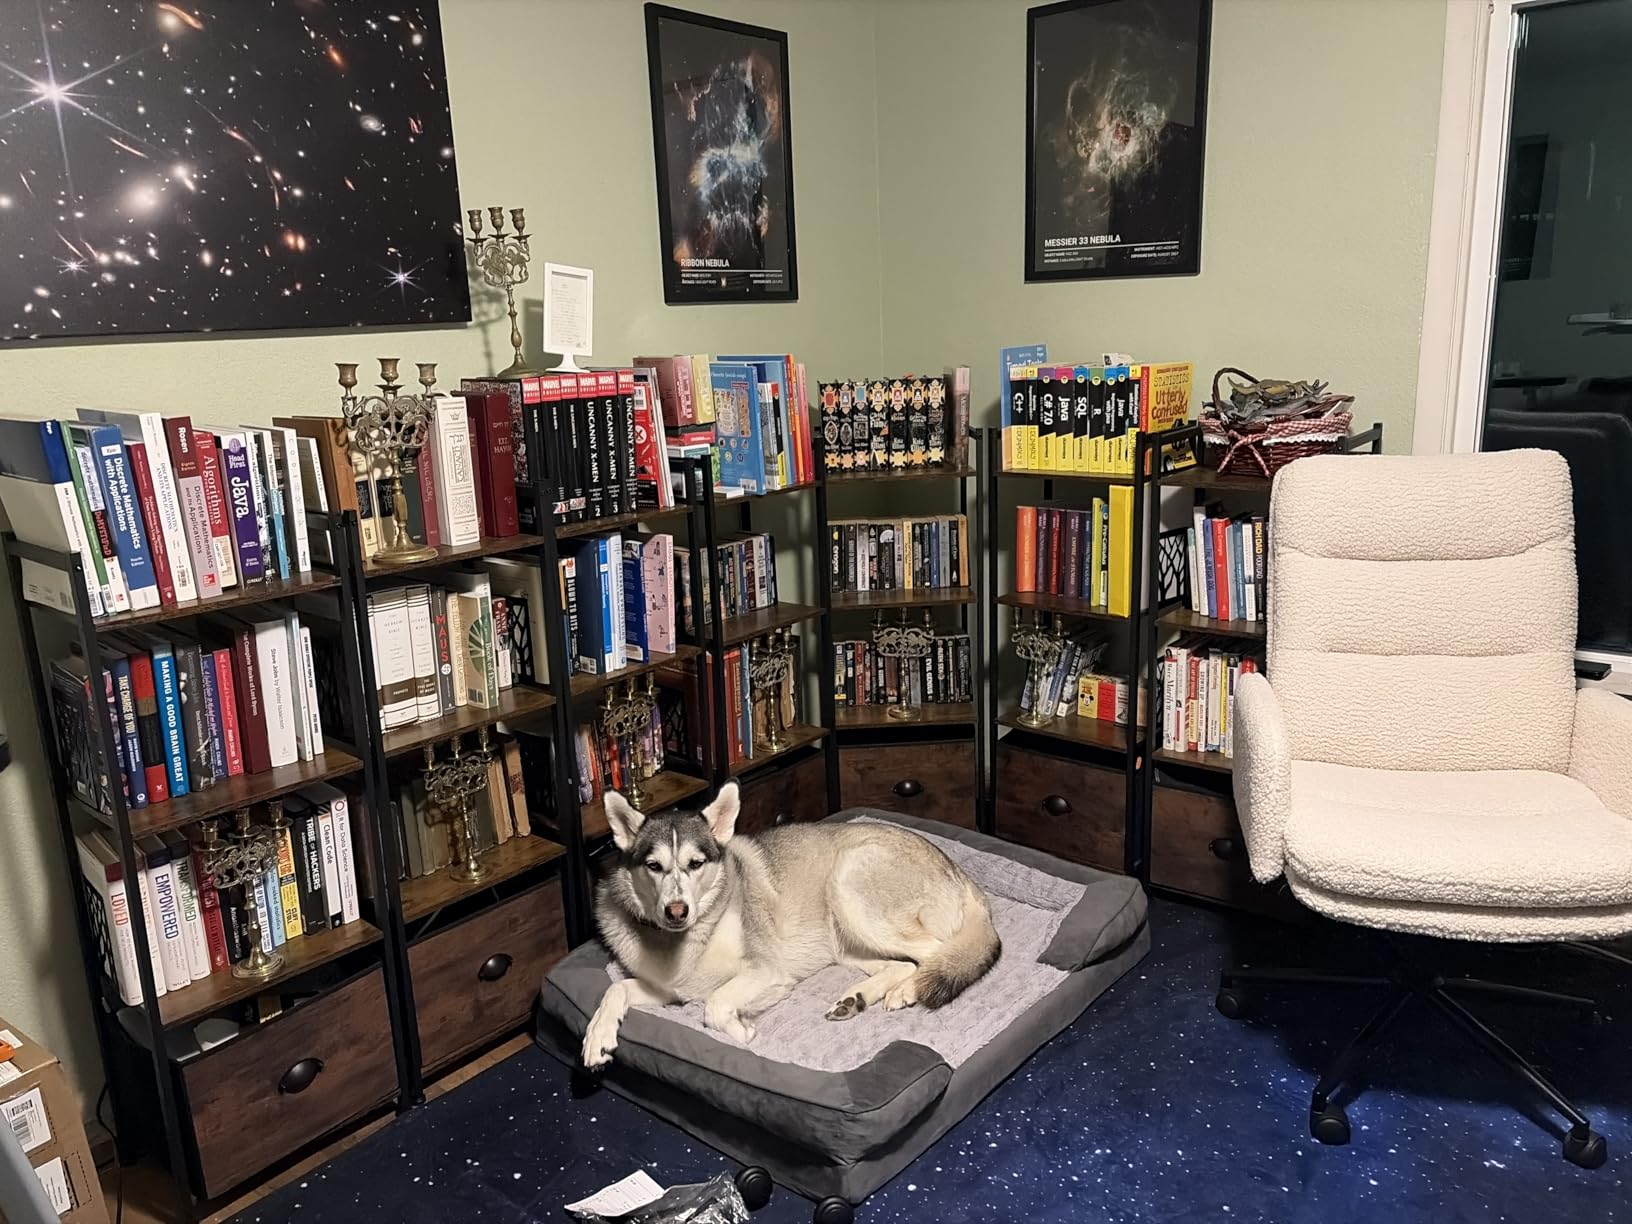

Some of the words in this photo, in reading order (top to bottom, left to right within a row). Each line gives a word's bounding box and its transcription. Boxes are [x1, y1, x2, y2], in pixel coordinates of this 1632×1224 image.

[1045, 237, 1077, 247] MESSIER
[1079, 237, 1088, 245] 33
[1090, 234, 1120, 244] NEBULA
[706, 259, 729, 267] NEBULA
[1154, 373, 1189, 387] STATISTICS
[1015, 393, 1024, 413] C++
[1044, 394, 1053, 408] C#
[1058, 397, 1070, 421] Java
[1078, 397, 1087, 418] SQL
[1156, 388, 1185, 406] Utterly
[586, 402, 597, 450] UNCANNY
[604, 400, 615, 448] UNCANNY
[624, 398, 634, 445] UNCANNY
[1044, 411, 1053, 425] 7.0
[177, 426, 190, 453] Rosen
[81, 452, 90, 476] discrete
[590, 452, 599, 483] X-MEN
[607, 449, 617, 480] X-MEN
[627, 448, 636, 477] X-MEN
[203, 456, 222, 525] Algorithms
[251, 462, 261, 500] algorithms
[85, 477, 99, 510] mathematics
[105, 460, 113, 478] with
[109, 479, 126, 531] Applications
[114, 458, 127, 493] Discrete
[123, 494, 141, 549] Mathematics
[231, 477, 249, 518] Java
[160, 492, 173, 531] APPLICATIONS
[166, 492, 179, 533] MATHEMATICS
[595, 508, 600, 516] 2
[613, 504, 618, 513] 3
[188, 506, 202, 554] Applications
[194, 486, 205, 518] Discrete
[201, 520, 214, 569] Mathematics
[566, 579, 576, 602] BLOWN
[499, 612, 507, 630] ANNE
[568, 604, 577, 614] TO
[569, 615, 578, 631] BITS
[436, 615, 448, 662] MAUS
[242, 642, 252, 666] Complete
[484, 642, 492, 661] Book
[161, 661, 171, 694] MAKING
[486, 662, 493, 671] of
[118, 676, 128, 690] TAKE
[487, 672, 495, 690] Days
[120, 691, 132, 713] CHARGE
[124, 721, 135, 733] YOU
[166, 704, 175, 728] GOOD
[169, 730, 179, 755] BRAIN
[173, 757, 183, 782] GREAT
[305, 817, 315, 842] TRIBE
[323, 824, 331, 844] Clean
[325, 846, 333, 865] Code
[341, 849, 349, 873] Science
[309, 852, 320, 891] HACKERS
[175, 862, 197, 921] TRANSFORMED
[110, 892, 129, 927] LOVED
[154, 874, 179, 940] EMPOWERED
[273, 906, 282, 931] statistics
